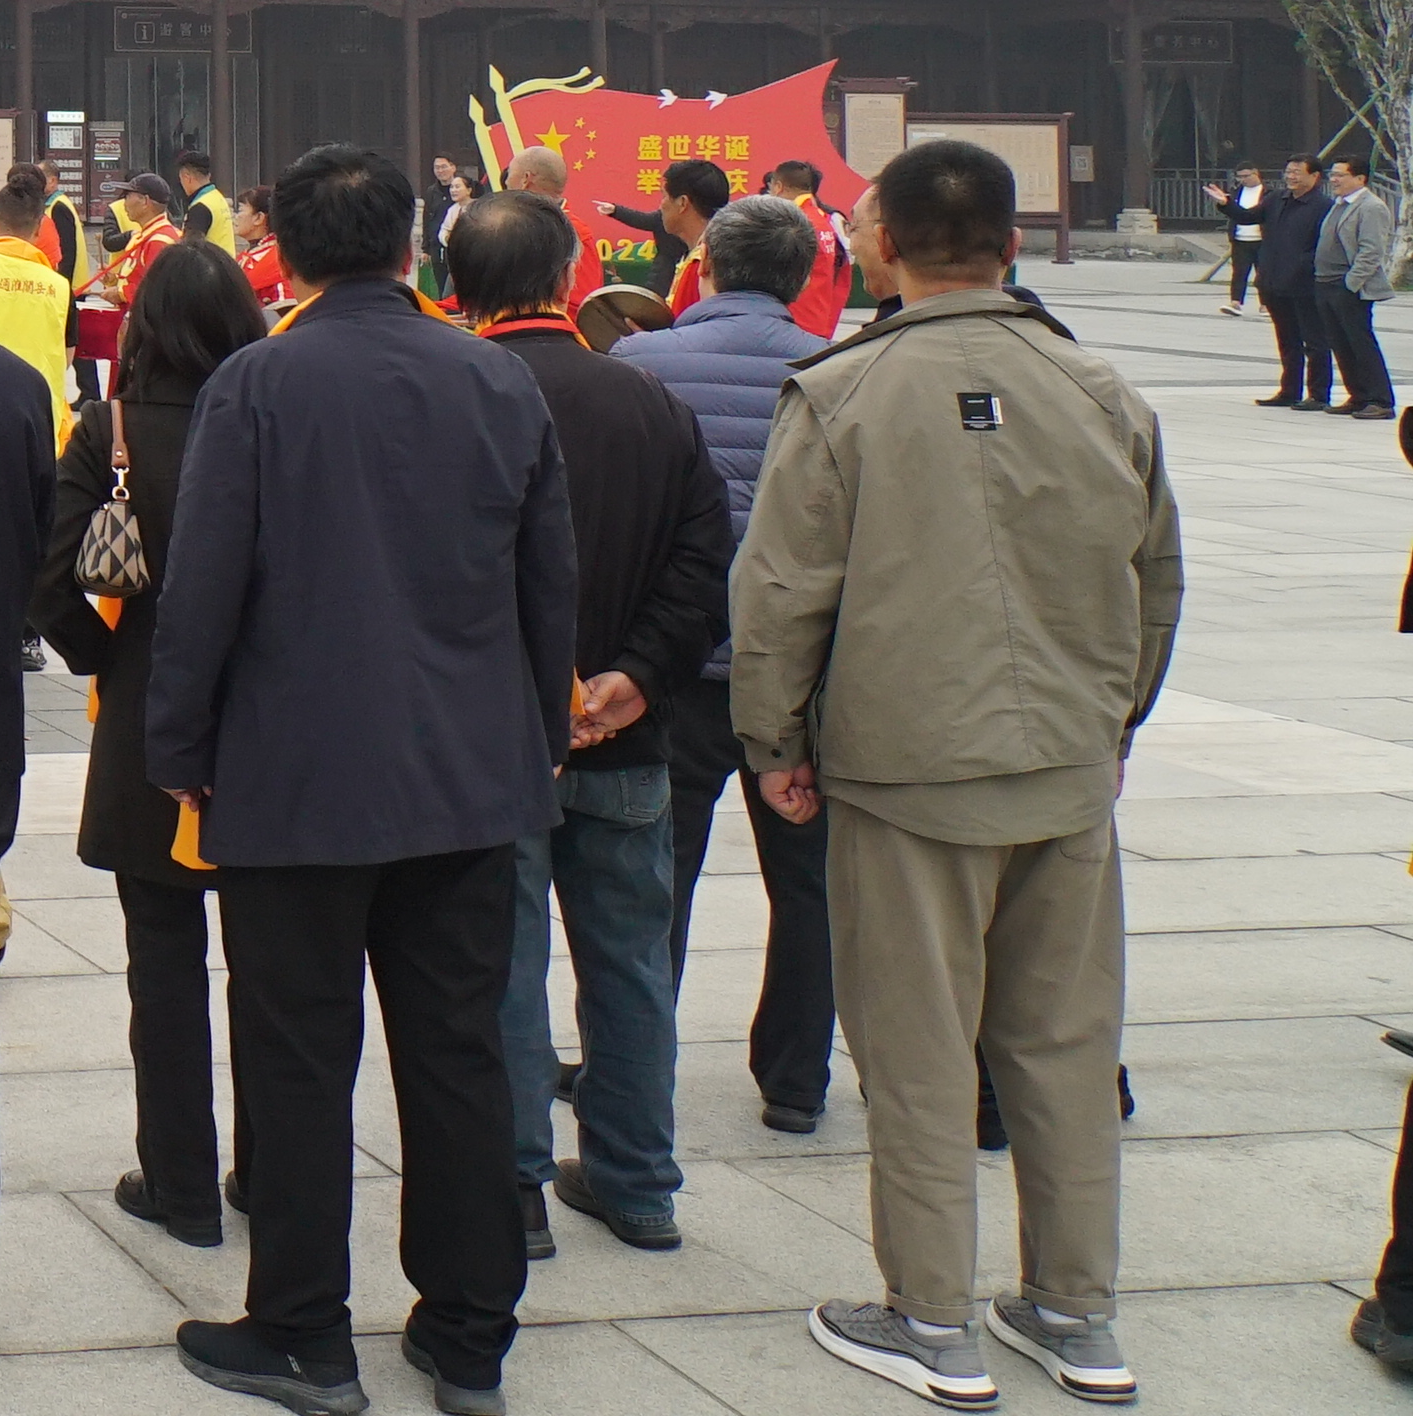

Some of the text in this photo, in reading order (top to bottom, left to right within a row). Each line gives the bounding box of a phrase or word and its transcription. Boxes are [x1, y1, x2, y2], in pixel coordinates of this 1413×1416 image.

[637, 135, 750, 161] 盛世华诞
[637, 169, 749, 195] 举庆
